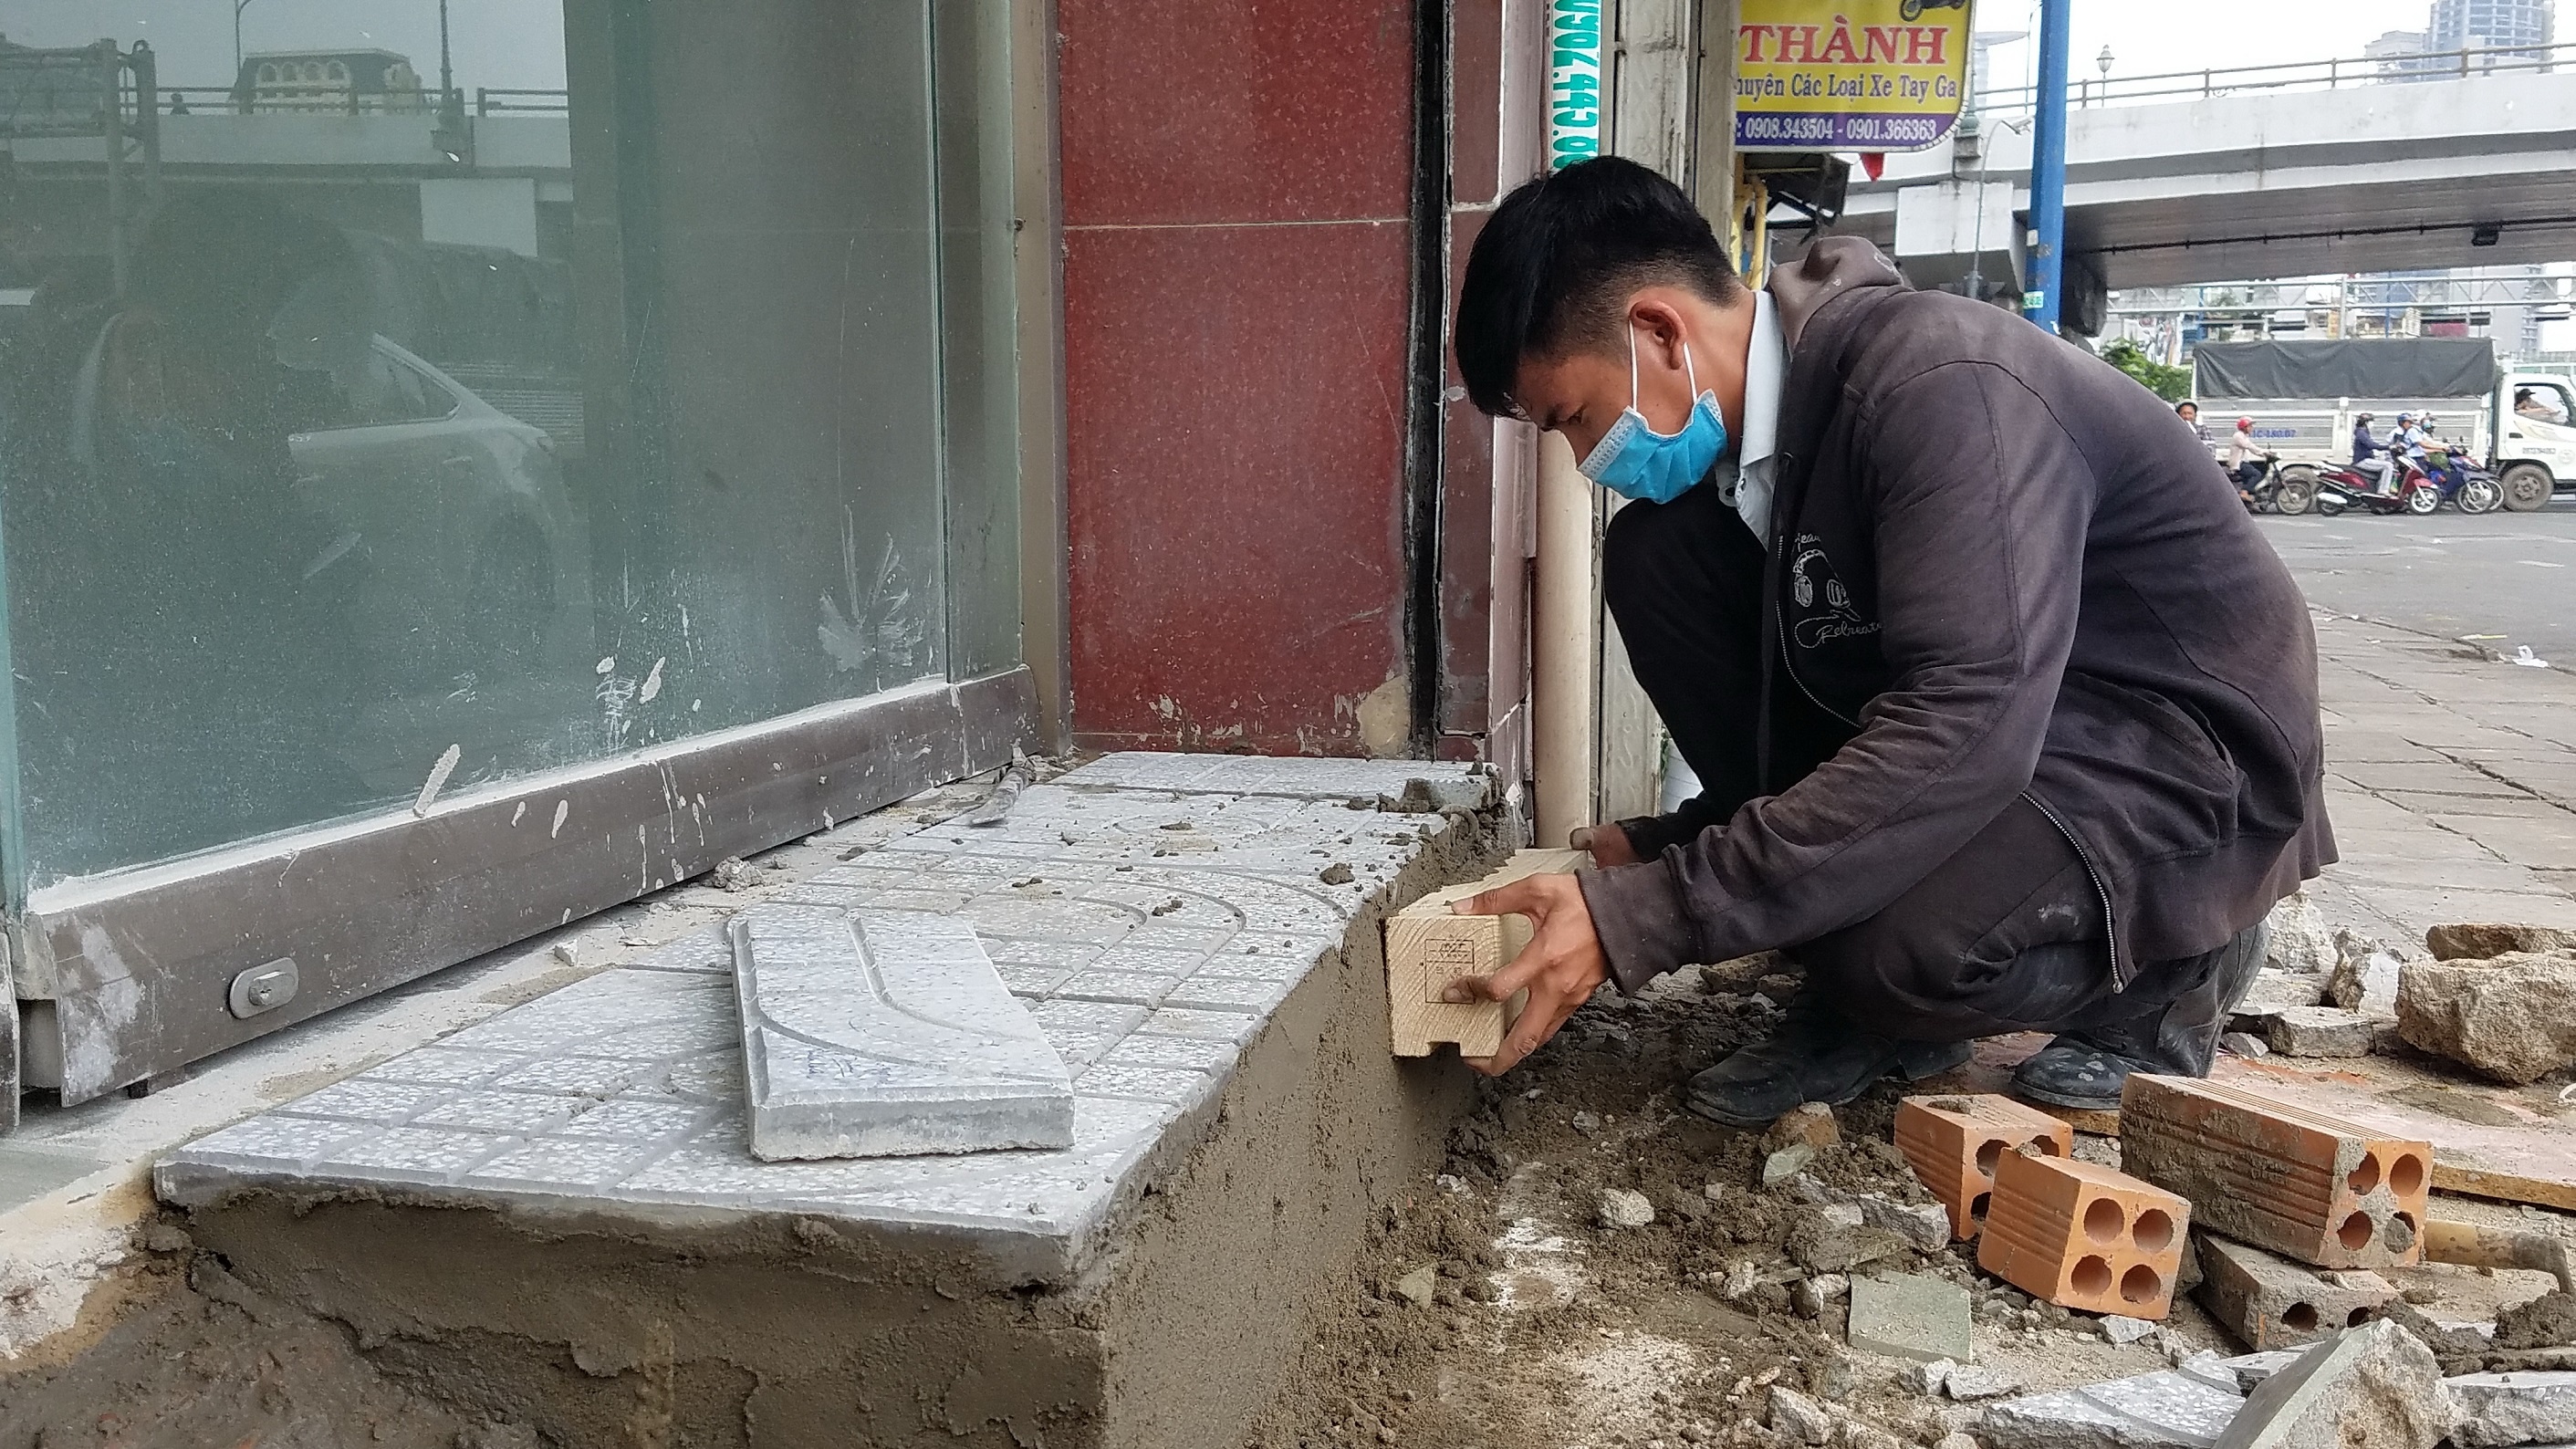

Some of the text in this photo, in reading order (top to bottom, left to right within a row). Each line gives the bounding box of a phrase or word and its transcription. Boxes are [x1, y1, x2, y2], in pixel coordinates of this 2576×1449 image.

[1738, 15, 1948, 65] THÀNH
[1791, 73, 1822, 97] Các
[1827, 73, 1864, 102] Loại
[1869, 74, 1893, 98] Xe
[1900, 75, 1930, 104] Tay
[1935, 74, 1957, 99] Ga
[1745, 117, 1833, 140] 0908.343504
[1846, 119, 1937, 141] 0901.366363
